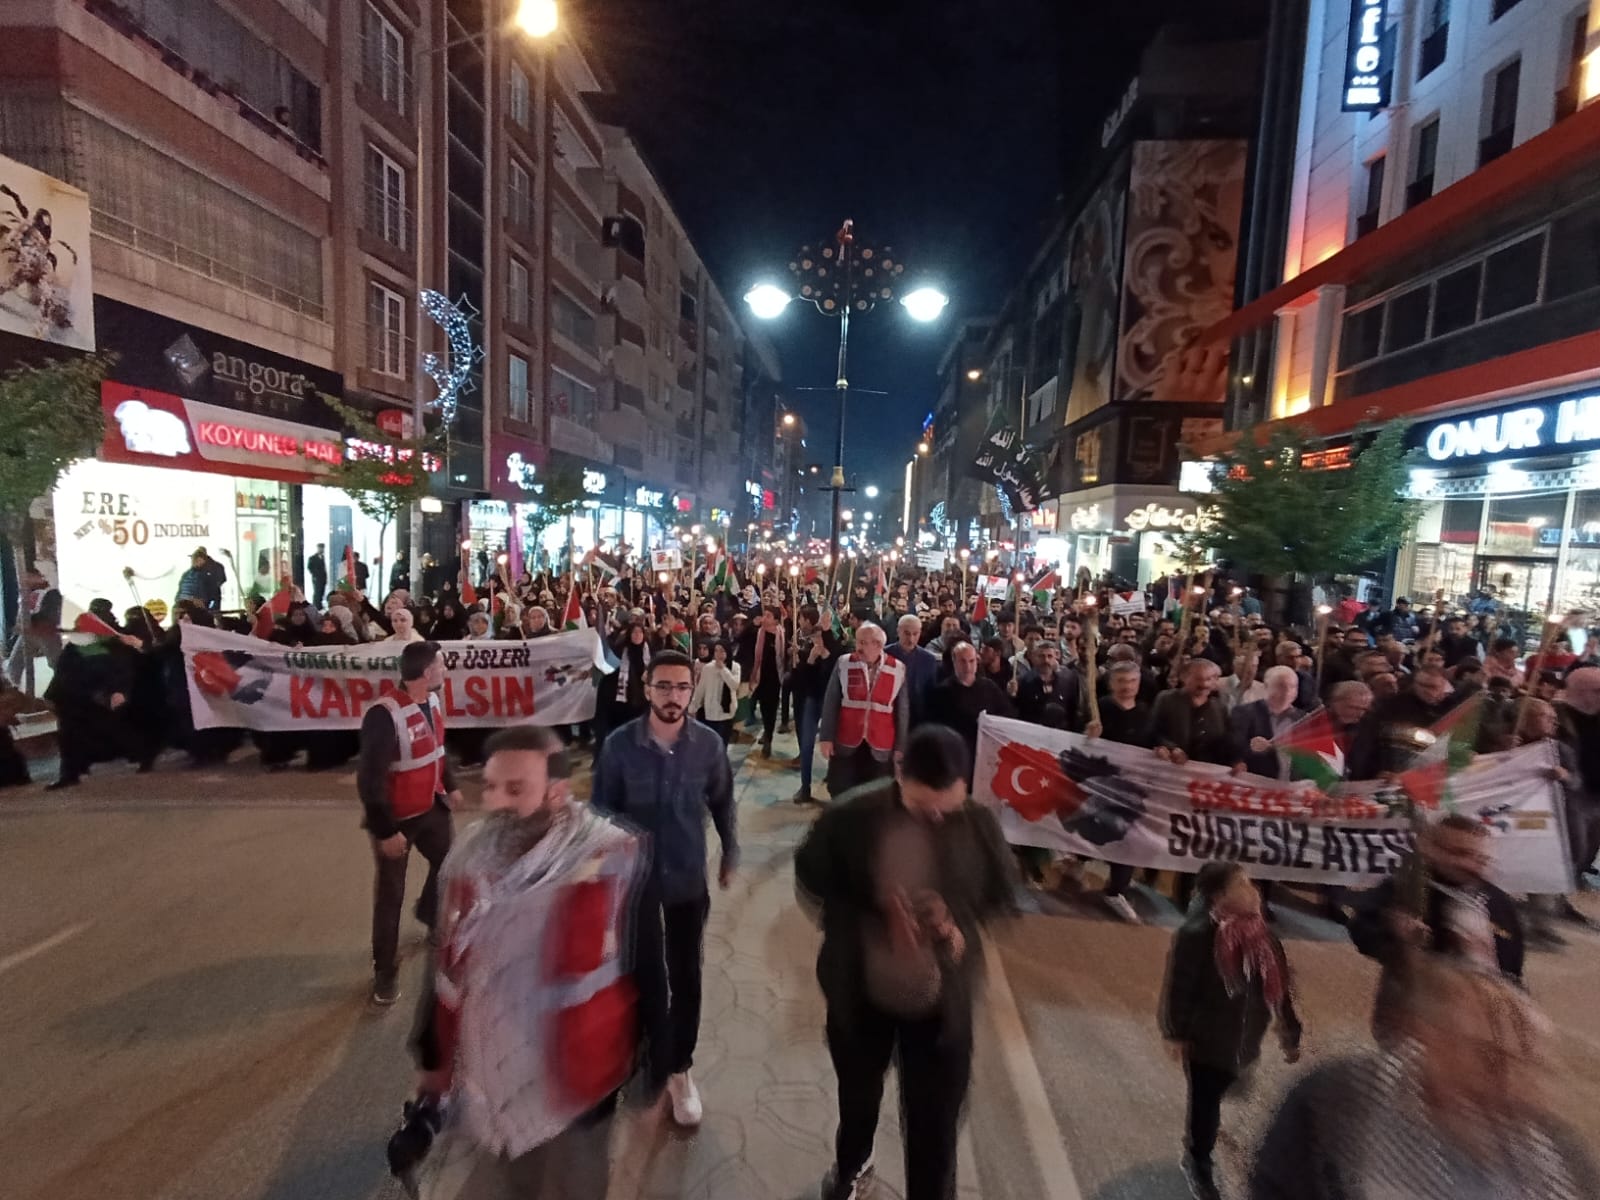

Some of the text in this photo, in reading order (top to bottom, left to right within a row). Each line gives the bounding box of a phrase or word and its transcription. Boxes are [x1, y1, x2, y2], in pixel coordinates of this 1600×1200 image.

[213, 351, 304, 395] angora
[199, 422, 299, 457] KOYUNLU
[1426, 407, 1545, 461] ONUR
[81, 490, 139, 517] ERE
[463, 642, 530, 670] ÜSLERİ
